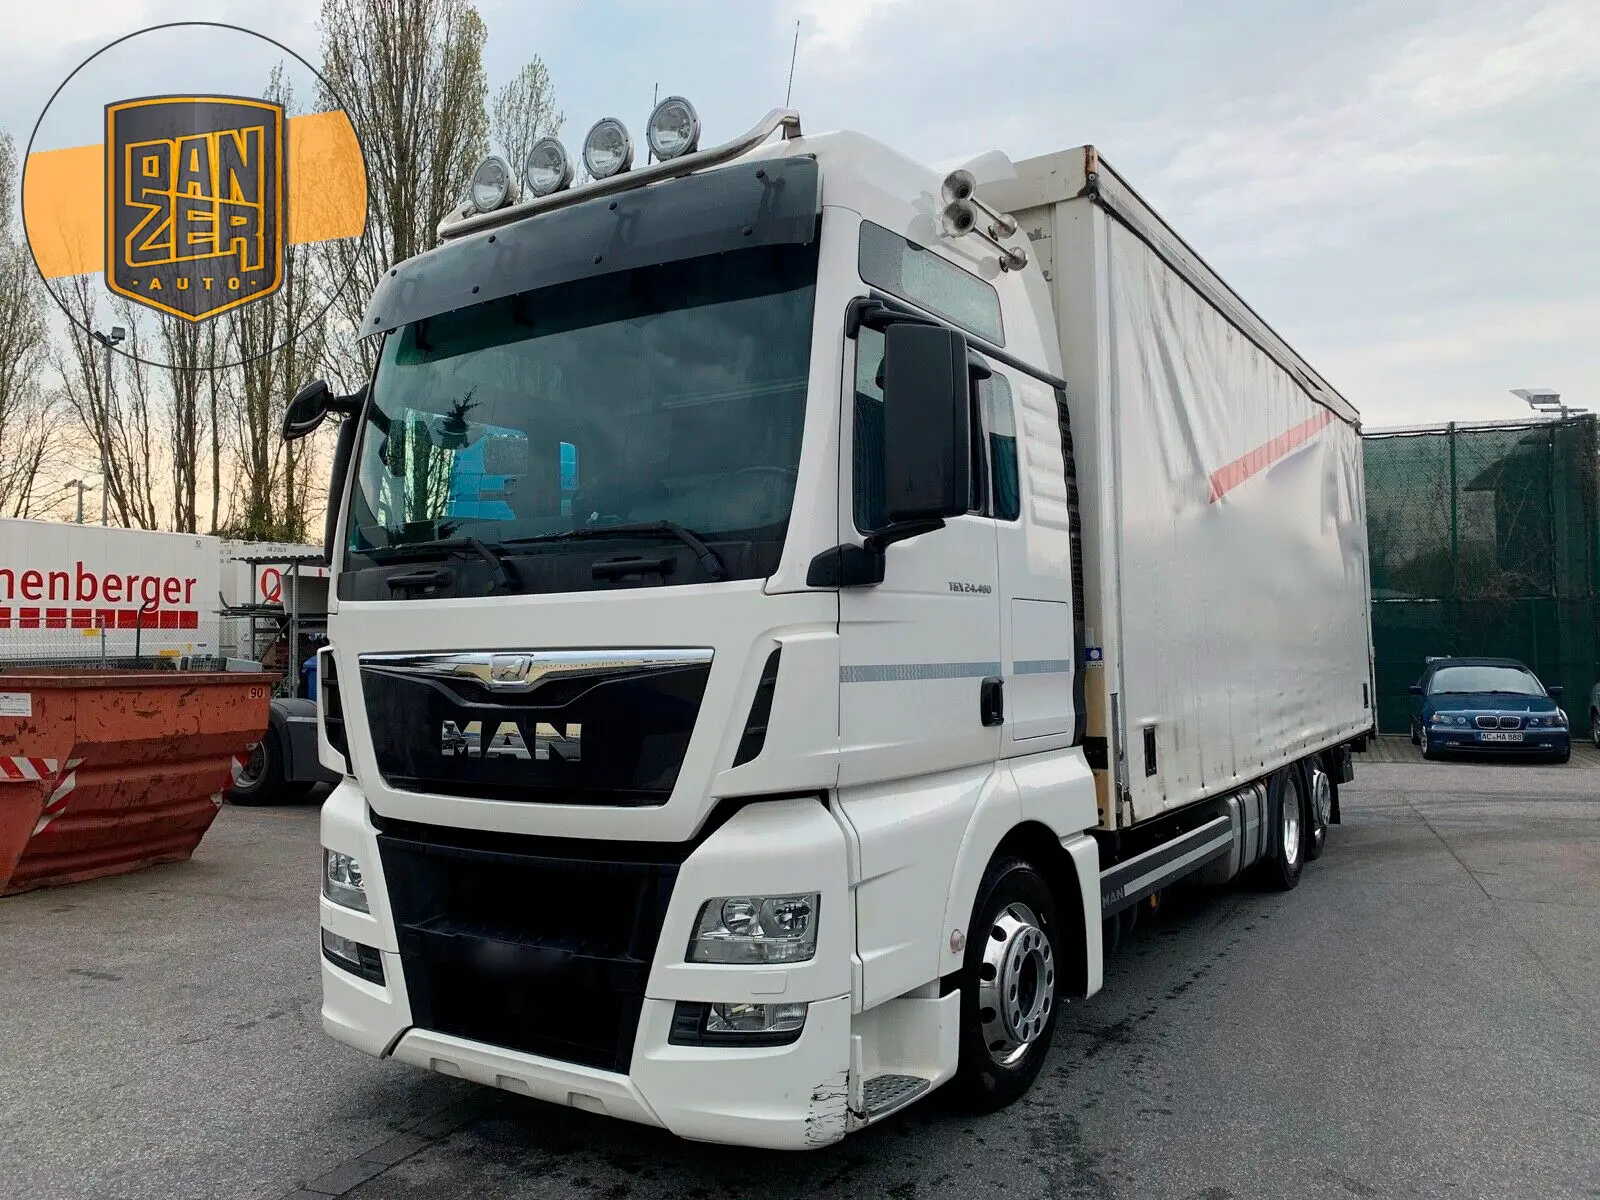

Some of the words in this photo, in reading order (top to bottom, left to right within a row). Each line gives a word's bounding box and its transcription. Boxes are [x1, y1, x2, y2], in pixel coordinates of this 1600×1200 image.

[250, 687, 263, 699] 90
[441, 719, 582, 762] MAN
[1102, 887, 1124, 908] MAN
